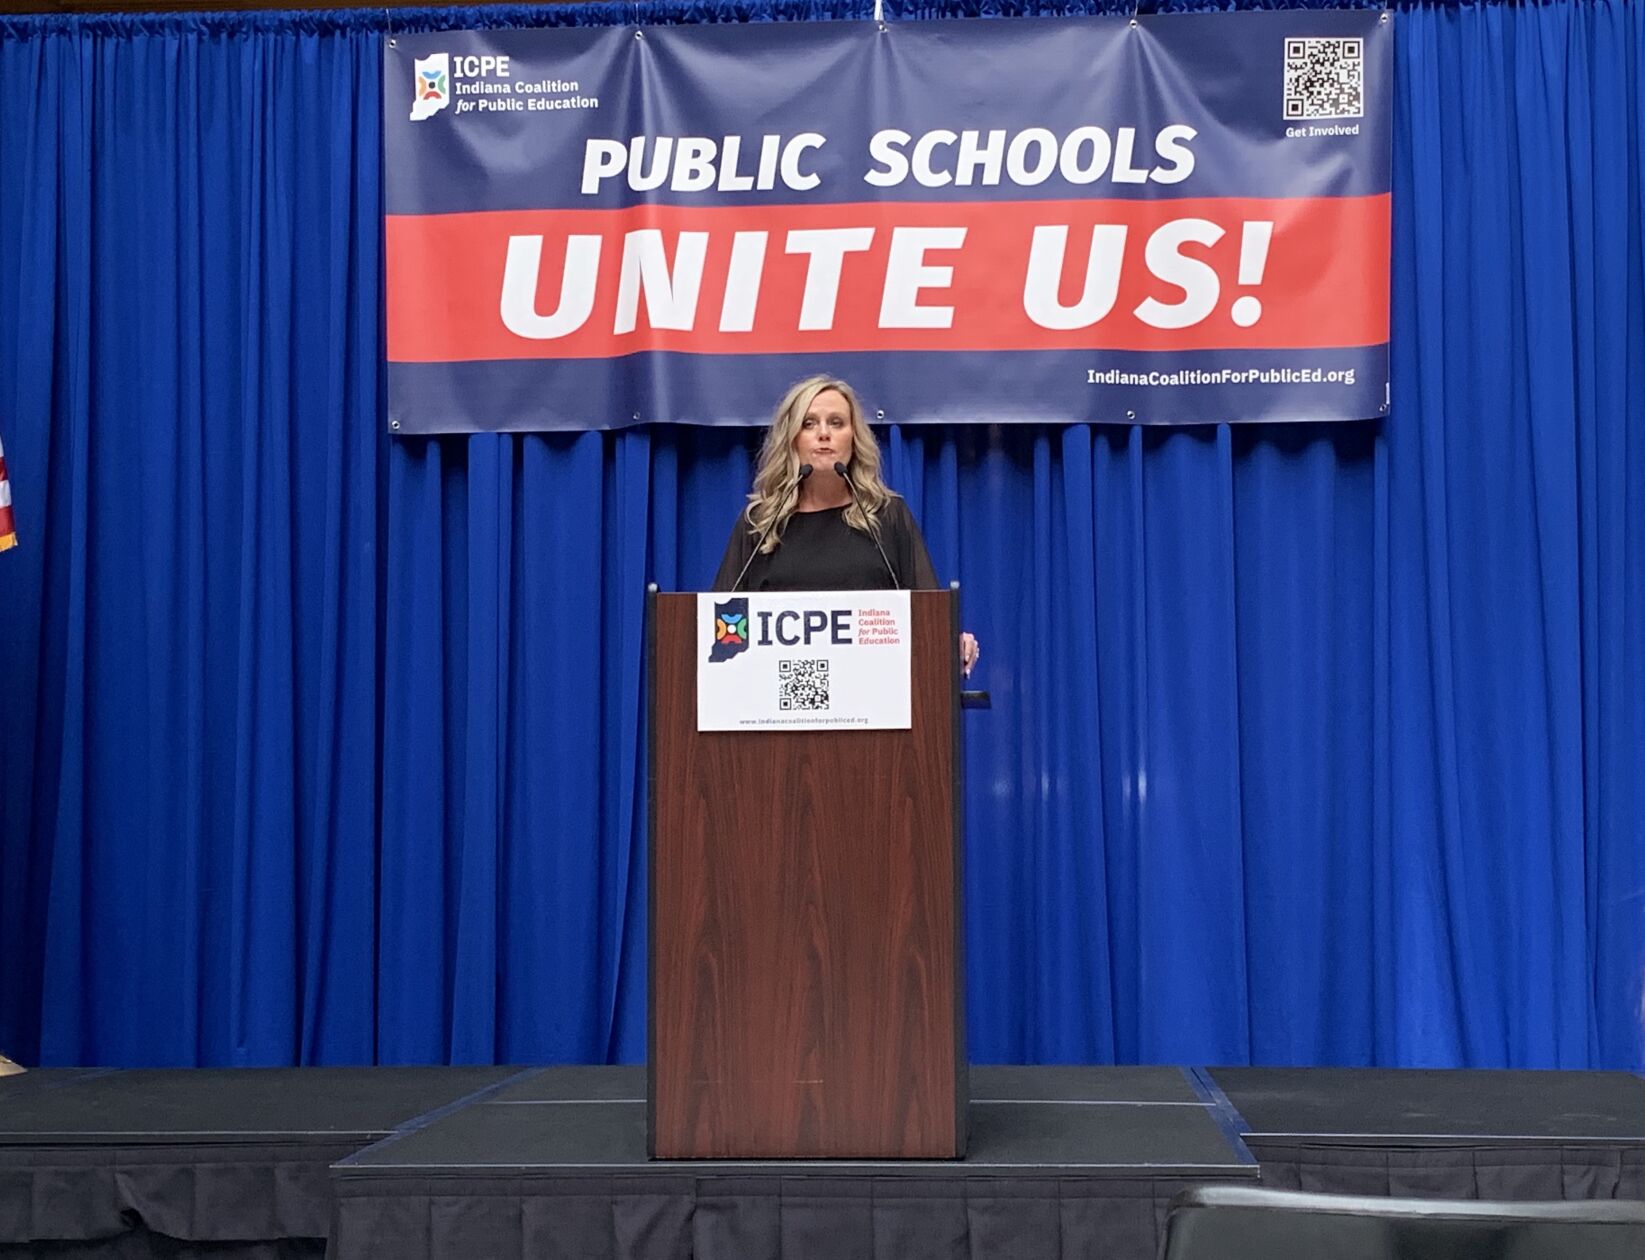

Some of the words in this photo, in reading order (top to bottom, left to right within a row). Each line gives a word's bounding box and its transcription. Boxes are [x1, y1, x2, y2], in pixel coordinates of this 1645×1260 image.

[453, 55, 510, 78] ICPE
[455, 81, 512, 94] Indiana
[514, 80, 579, 93] Coalition
[455, 99, 476, 114] for
[478, 98, 524, 111] Public
[527, 96, 599, 110] Education
[1285, 127, 1306, 137] Get
[1308, 124, 1360, 137] Involved
[581, 132, 827, 194] PUBLIC
[864, 125, 1198, 186] SCHOOLS
[500, 227, 968, 339] UNITE
[1022, 217, 1274, 330] US!
[1086, 368, 1356, 386] IndianaCoalitionForPublicEd.org
[858, 609, 890, 617] Indiana
[757, 610, 853, 646] ICPE
[858, 618, 896, 626] Coalition
[858, 628, 870, 636] for
[872, 627, 899, 635] Public
[858, 637, 900, 645] Education
